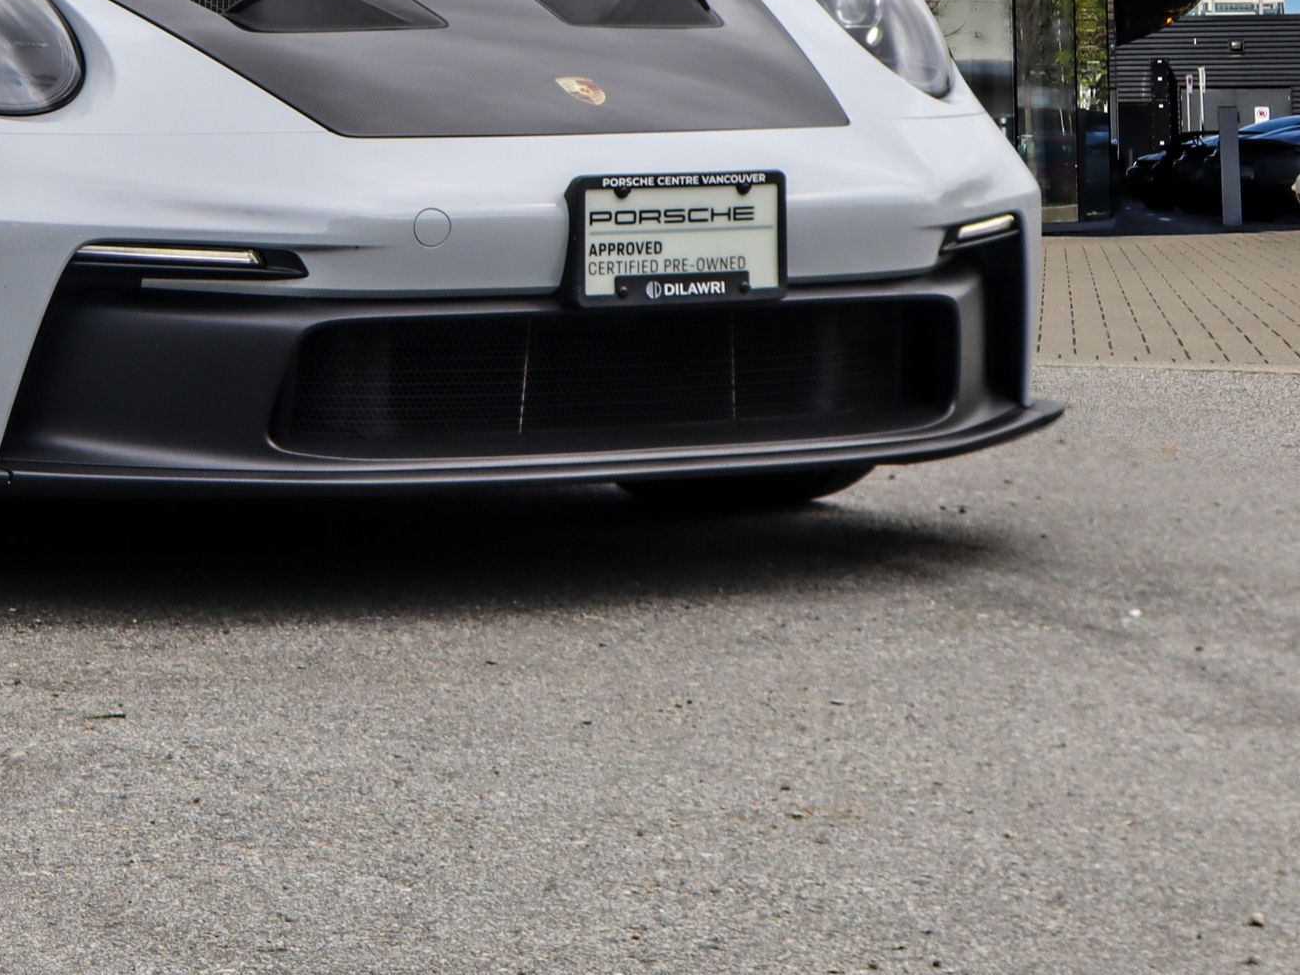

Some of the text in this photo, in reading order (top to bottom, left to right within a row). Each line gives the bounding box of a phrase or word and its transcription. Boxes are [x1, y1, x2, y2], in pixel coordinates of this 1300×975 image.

[602, 173, 766, 187] PORSCHE CENTRE VANCOUVER
[589, 206, 755, 226] PORSCHE
[588, 241, 663, 257] APPROVED
[588, 256, 746, 276] CERTIFIED PRE-OWNED
[664, 280, 726, 296] DILAWRI
